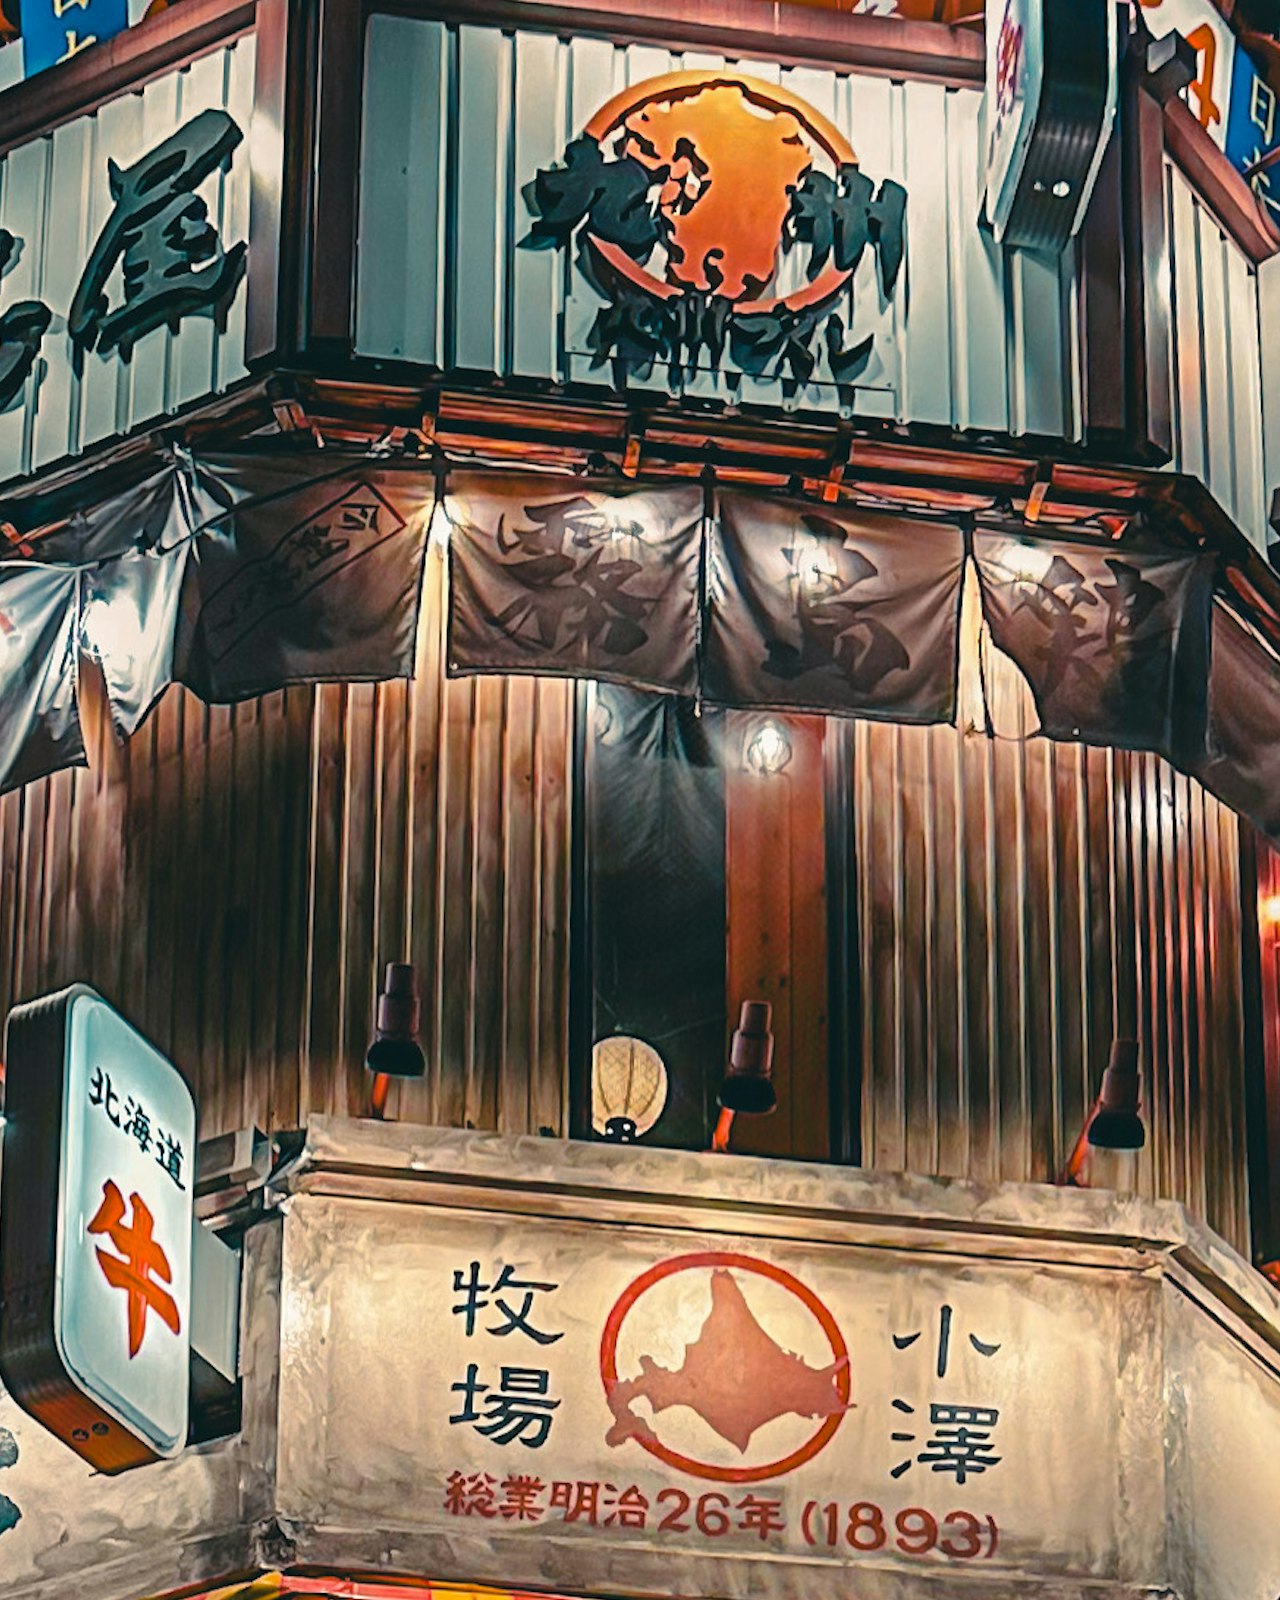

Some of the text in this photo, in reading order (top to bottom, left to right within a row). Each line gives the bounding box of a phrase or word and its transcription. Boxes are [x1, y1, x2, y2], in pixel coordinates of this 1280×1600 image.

[88, 1065, 187, 1192] 北海道
[86, 1177, 183, 1361] 牛
[448, 1259, 565, 1449] 牧場
[890, 1304, 1002, 1486] 小澤
[800, 1500, 1001, 1562] (1893)
